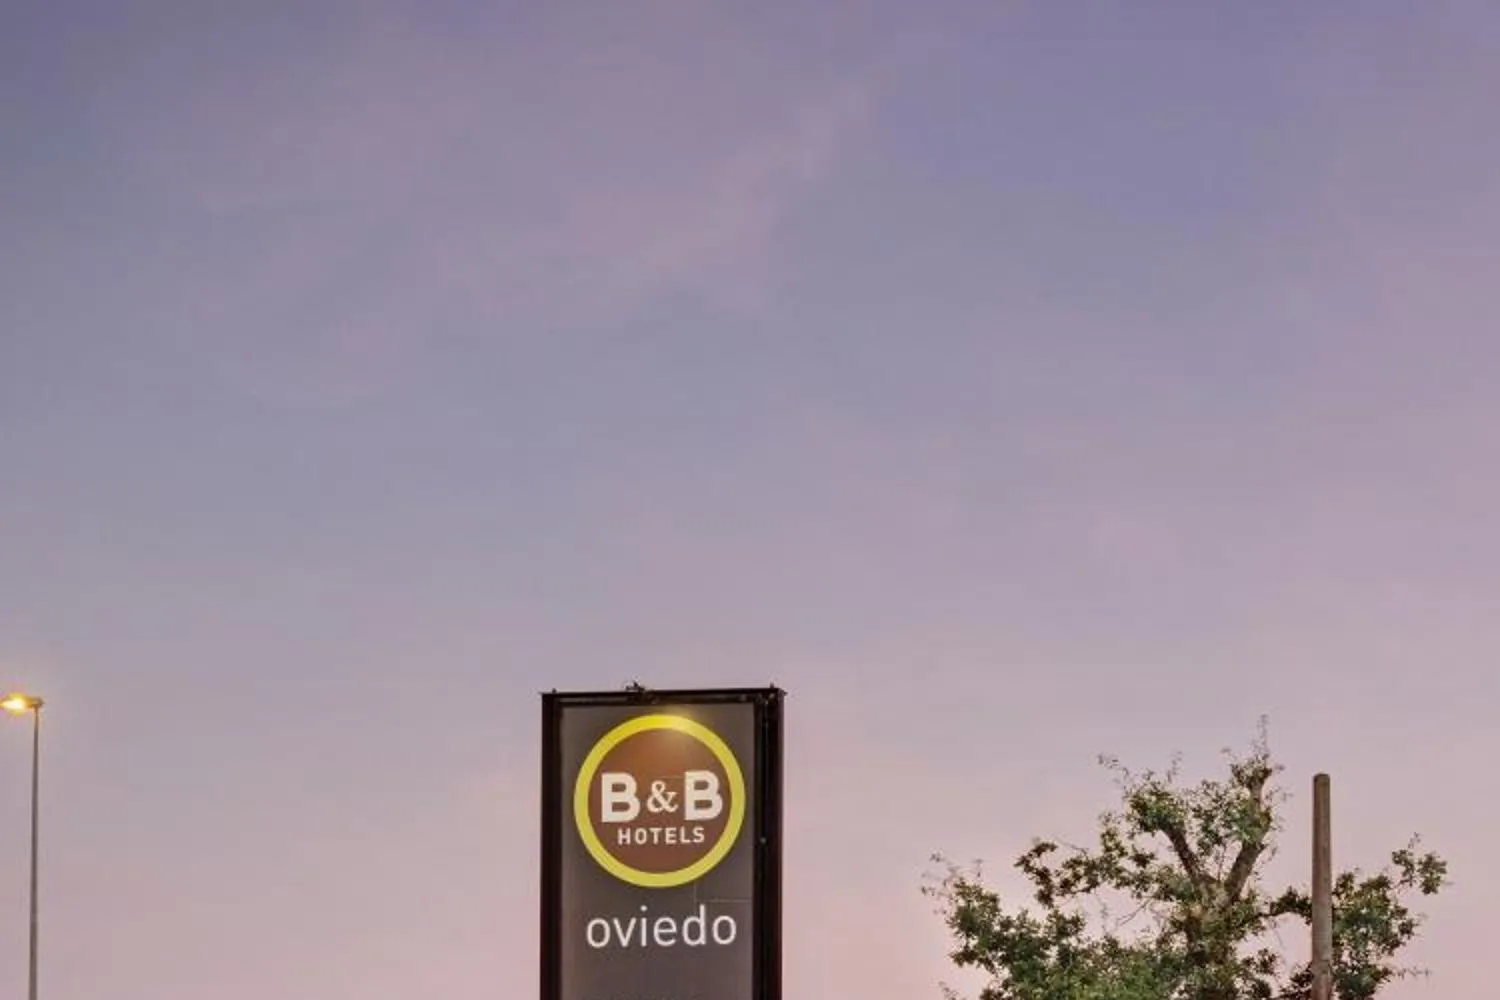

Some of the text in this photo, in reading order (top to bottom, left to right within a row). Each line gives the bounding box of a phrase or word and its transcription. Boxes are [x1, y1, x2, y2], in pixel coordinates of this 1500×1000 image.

[602, 770, 723, 823] B&B
[617, 827, 705, 845] HOTELS
[586, 904, 737, 948] oviedo
